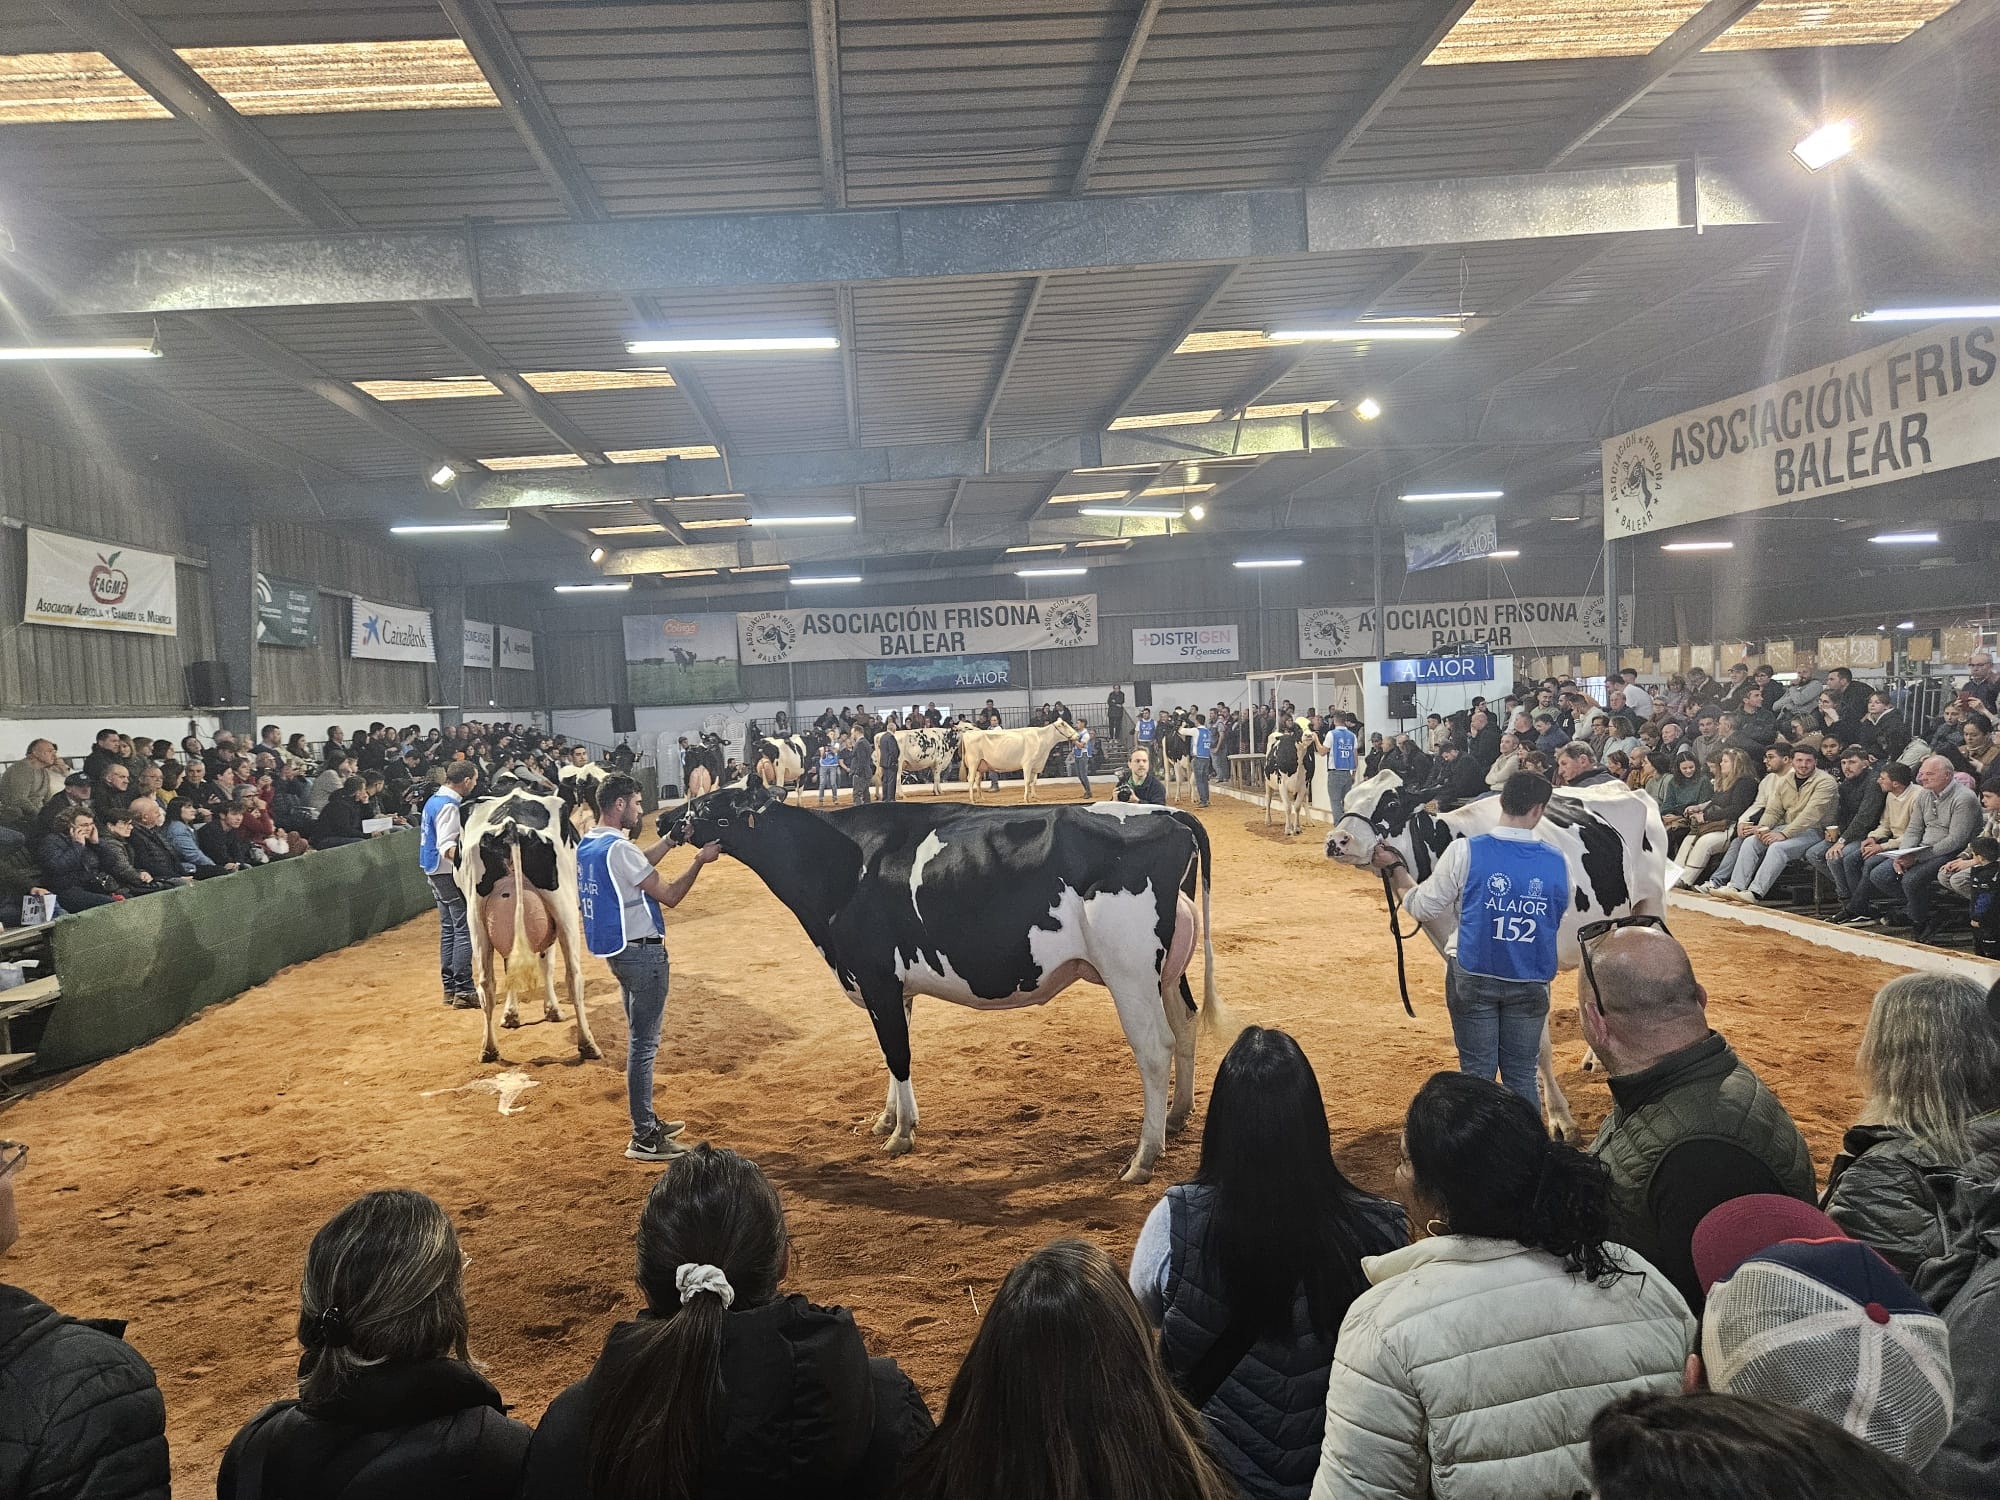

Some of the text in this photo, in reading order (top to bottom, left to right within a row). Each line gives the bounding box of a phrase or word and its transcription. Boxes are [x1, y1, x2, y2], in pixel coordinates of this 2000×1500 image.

[1669, 326, 1998, 471] ASOCIACIÓN FRIS
[1643, 435, 1663, 491] FRISONA
[1773, 411, 1932, 496] BALEAR
[1620, 510, 1654, 531] BALEAR
[1456, 531, 1496, 557] ALAIOR
[93, 577, 127, 595] FAGME
[778, 614, 796, 644] FRISONA
[802, 604, 1041, 635] ASOCIACIÓN FRISONA
[1358, 602, 1579, 632] AOCIACIÓN FRISONA
[382, 620, 427, 648] CaixaBank
[880, 631, 966, 656] BALEAR
[1054, 636, 1083, 646] BALEAR
[757, 651, 788, 662] BALEAR
[1313, 646, 1343, 657] BALEAR
[955, 671, 1008, 685] ALAIOR
[1401, 659, 1476, 679] ALAIOR
[1485, 897, 1547, 916] ALAIOR
[1492, 916, 1537, 943] 152
